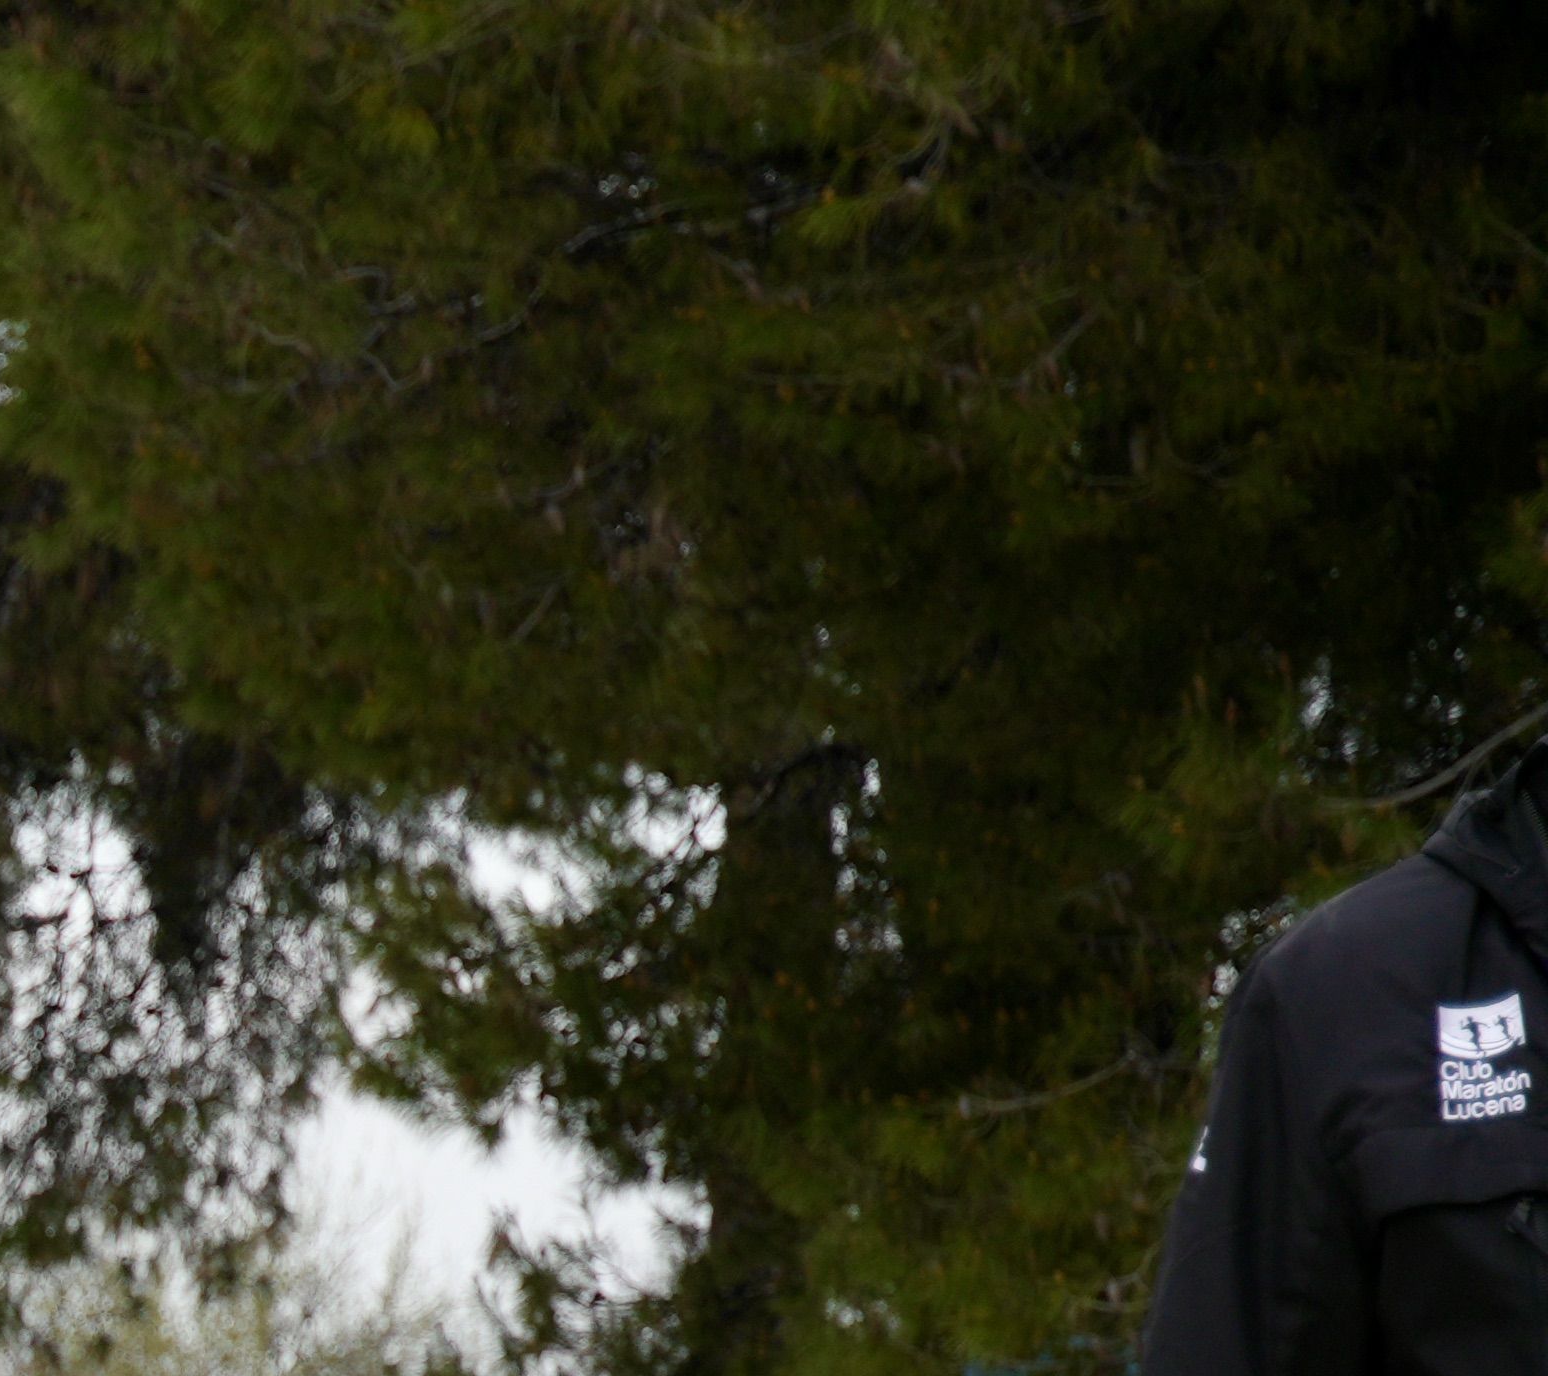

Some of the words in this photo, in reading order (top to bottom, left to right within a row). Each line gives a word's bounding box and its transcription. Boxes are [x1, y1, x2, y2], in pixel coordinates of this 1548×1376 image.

[1441, 1061, 1492, 1081] Club
[1441, 1070, 1531, 1099] Maratón
[1442, 1094, 1526, 1120] Lucena
